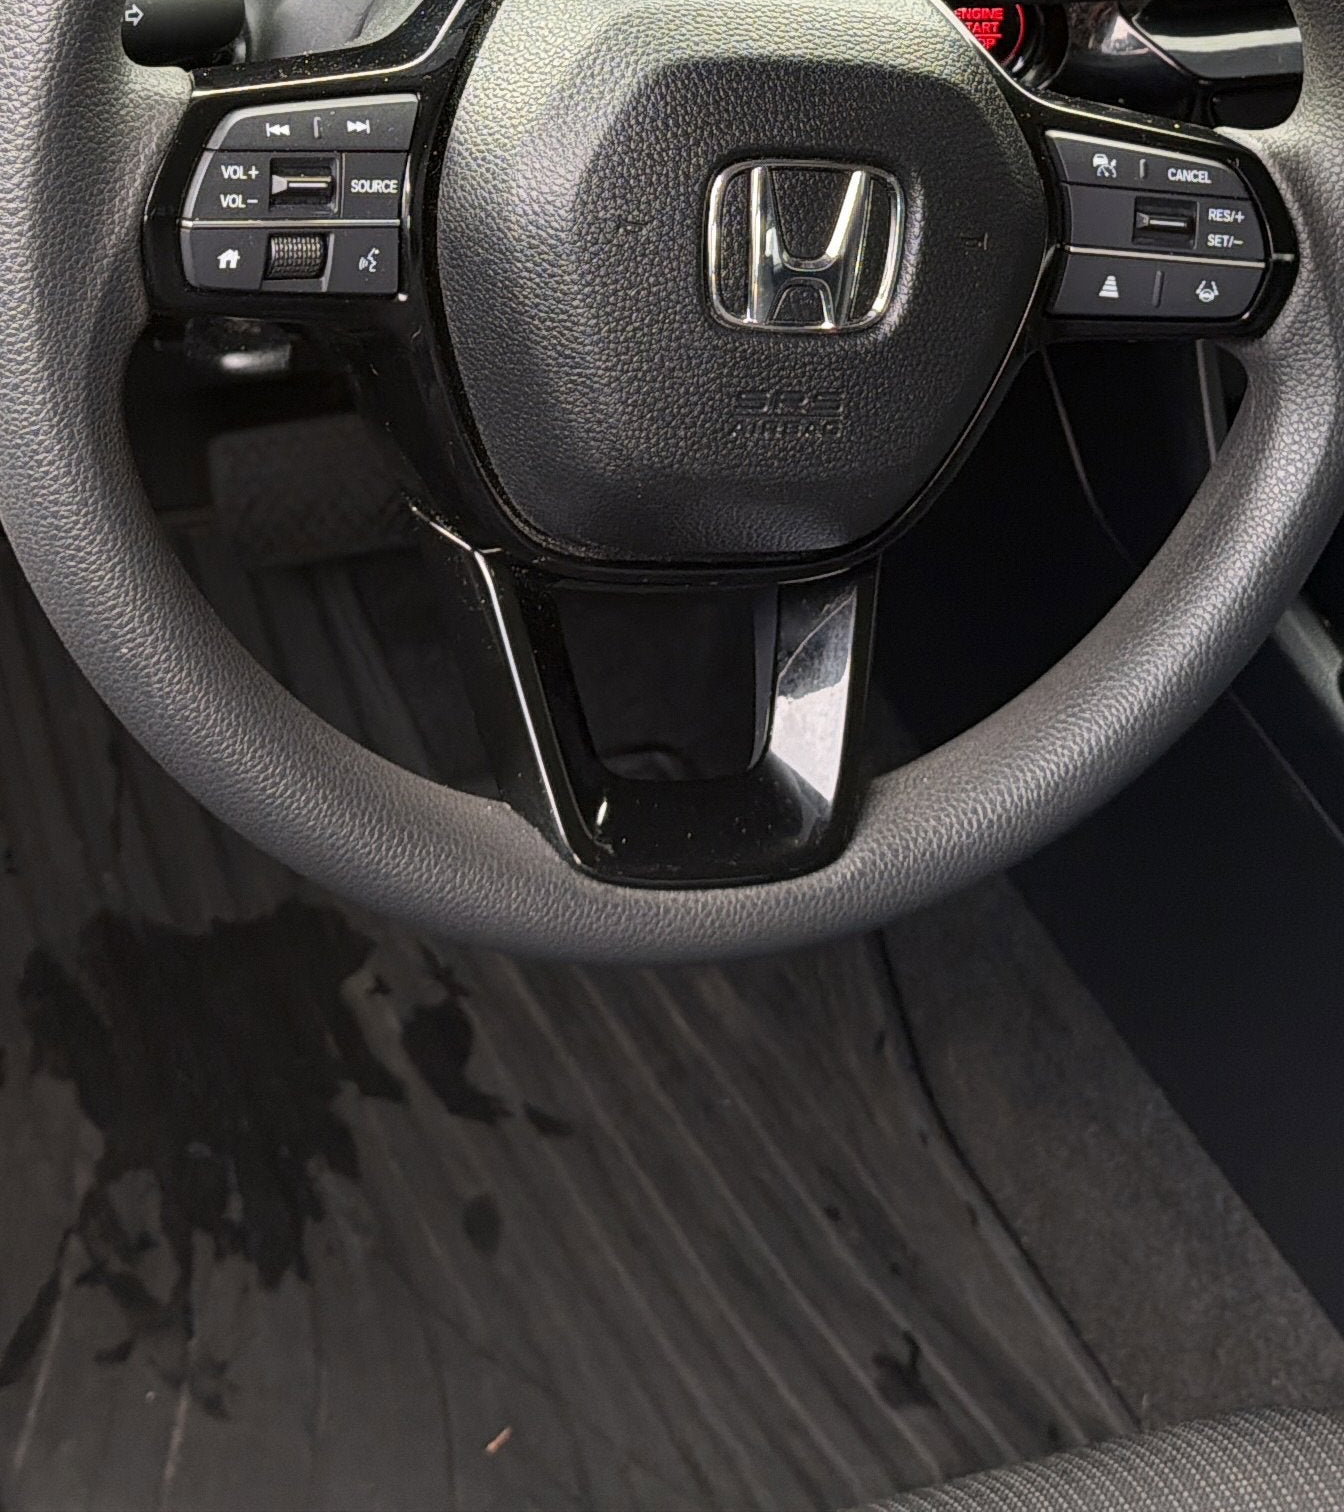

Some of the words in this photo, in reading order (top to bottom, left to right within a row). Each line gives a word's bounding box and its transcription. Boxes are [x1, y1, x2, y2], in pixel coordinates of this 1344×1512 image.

[954, 7, 1005, 21] ENGINE
[967, 21, 1000, 33] TART
[221, 165, 260, 180] VOL+
[1167, 168, 1212, 185] CANCEL
[350, 179, 398, 194] SOURCE
[1208, 208, 1245, 224] RES/+
